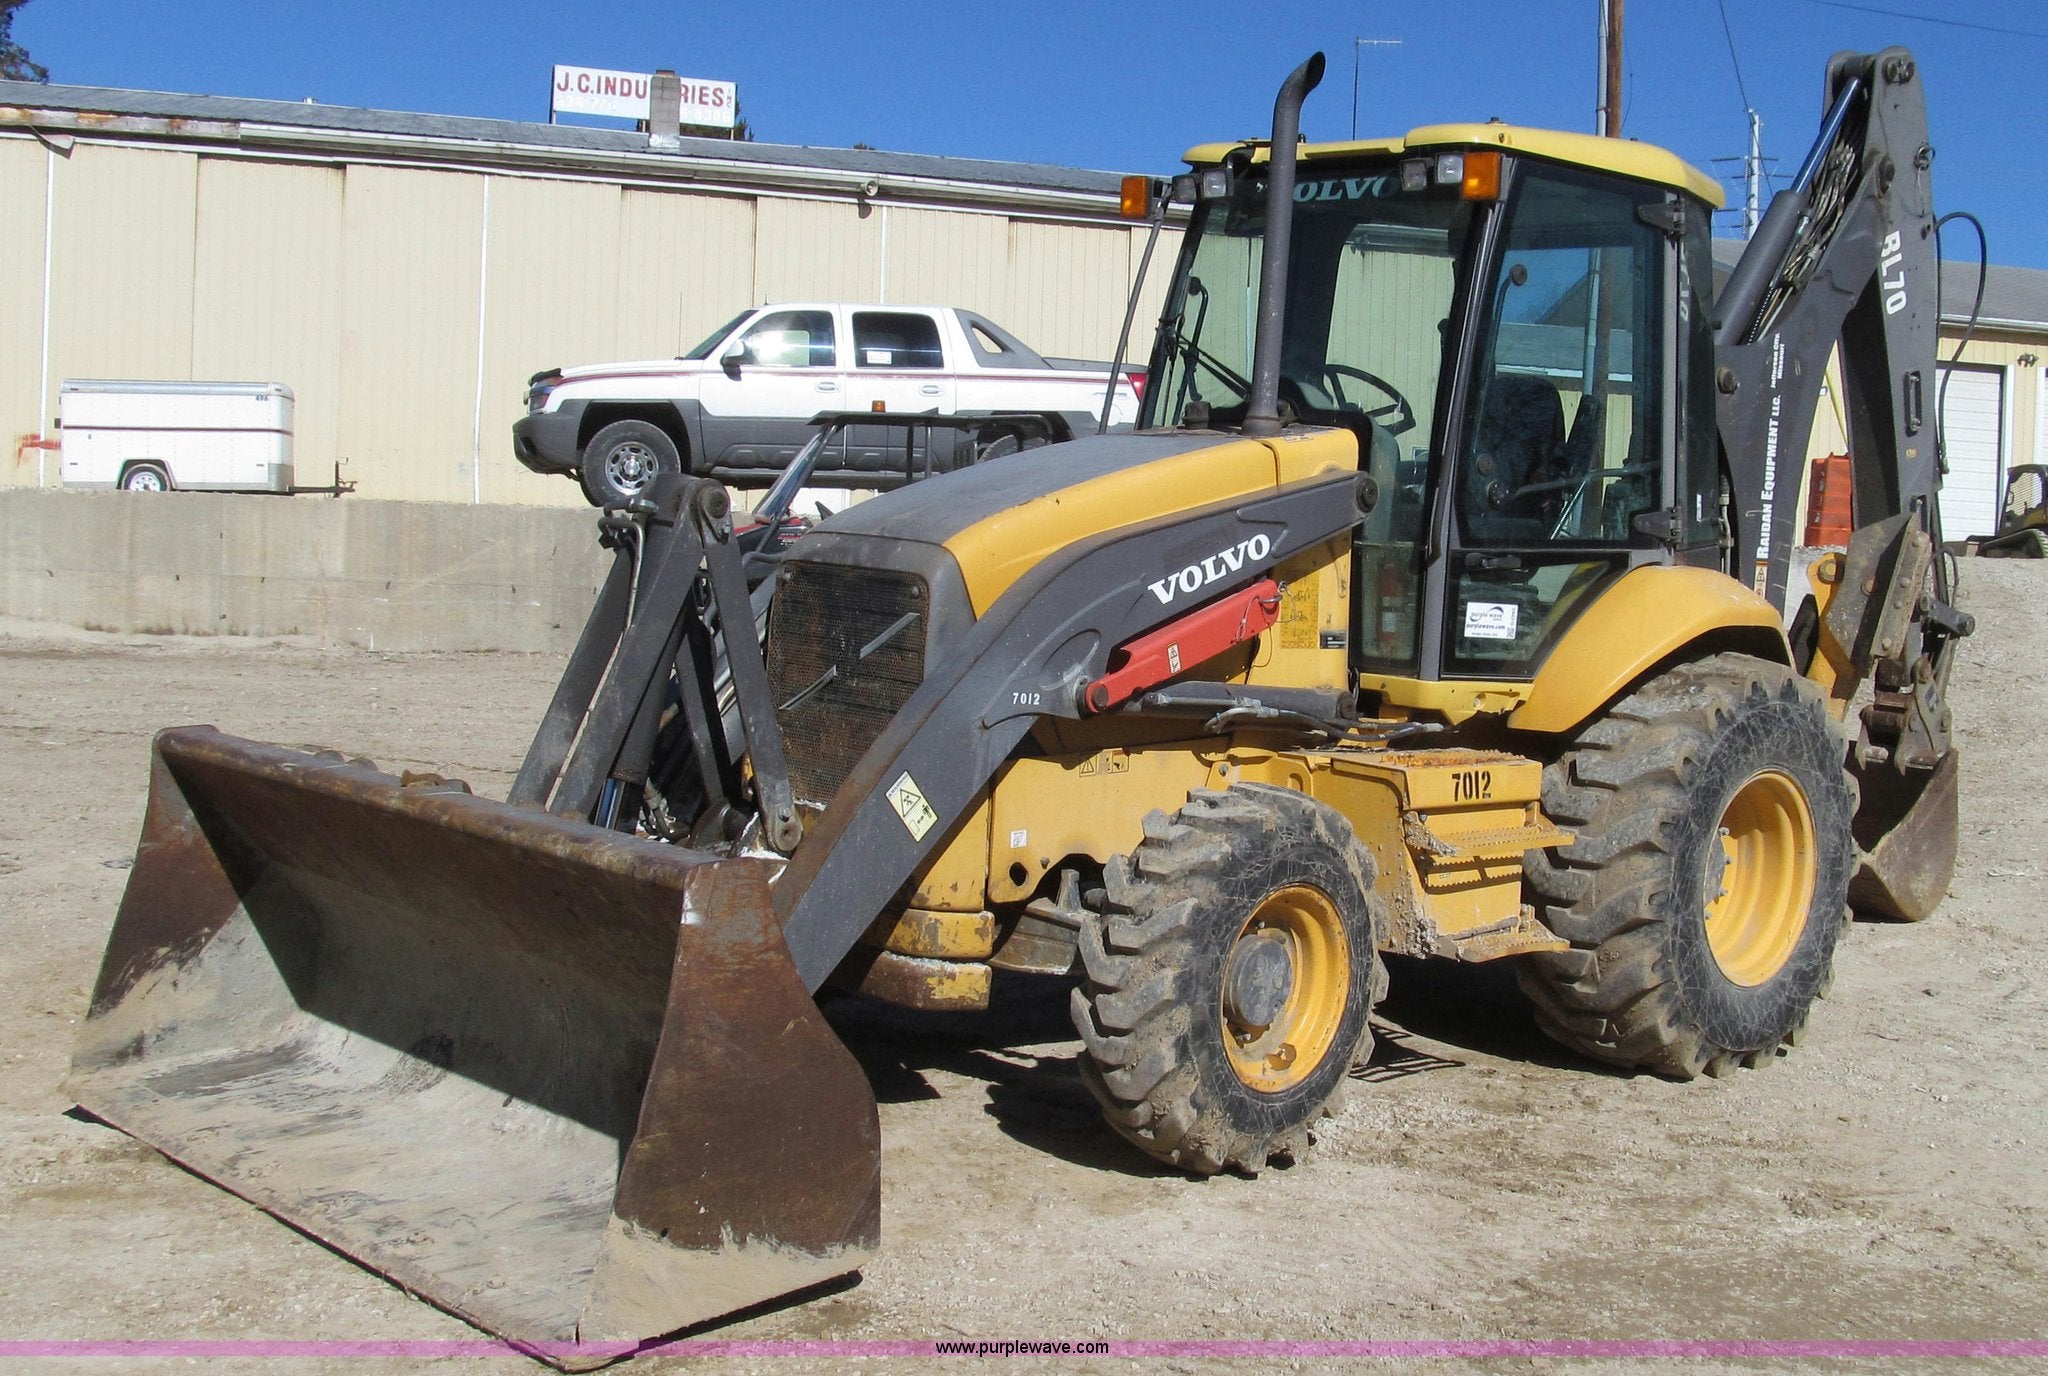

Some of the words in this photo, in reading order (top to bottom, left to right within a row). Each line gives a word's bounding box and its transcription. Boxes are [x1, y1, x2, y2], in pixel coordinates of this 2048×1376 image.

[557, 71, 724, 108] J.C.INDURIES
[1292, 175, 1400, 202] OLVO
[1760, 418, 1779, 501] EQUIPMENT
[1147, 533, 1271, 605] VOLVO
[1012, 692, 1041, 705] 7012
[1451, 770, 1492, 802] 7012
